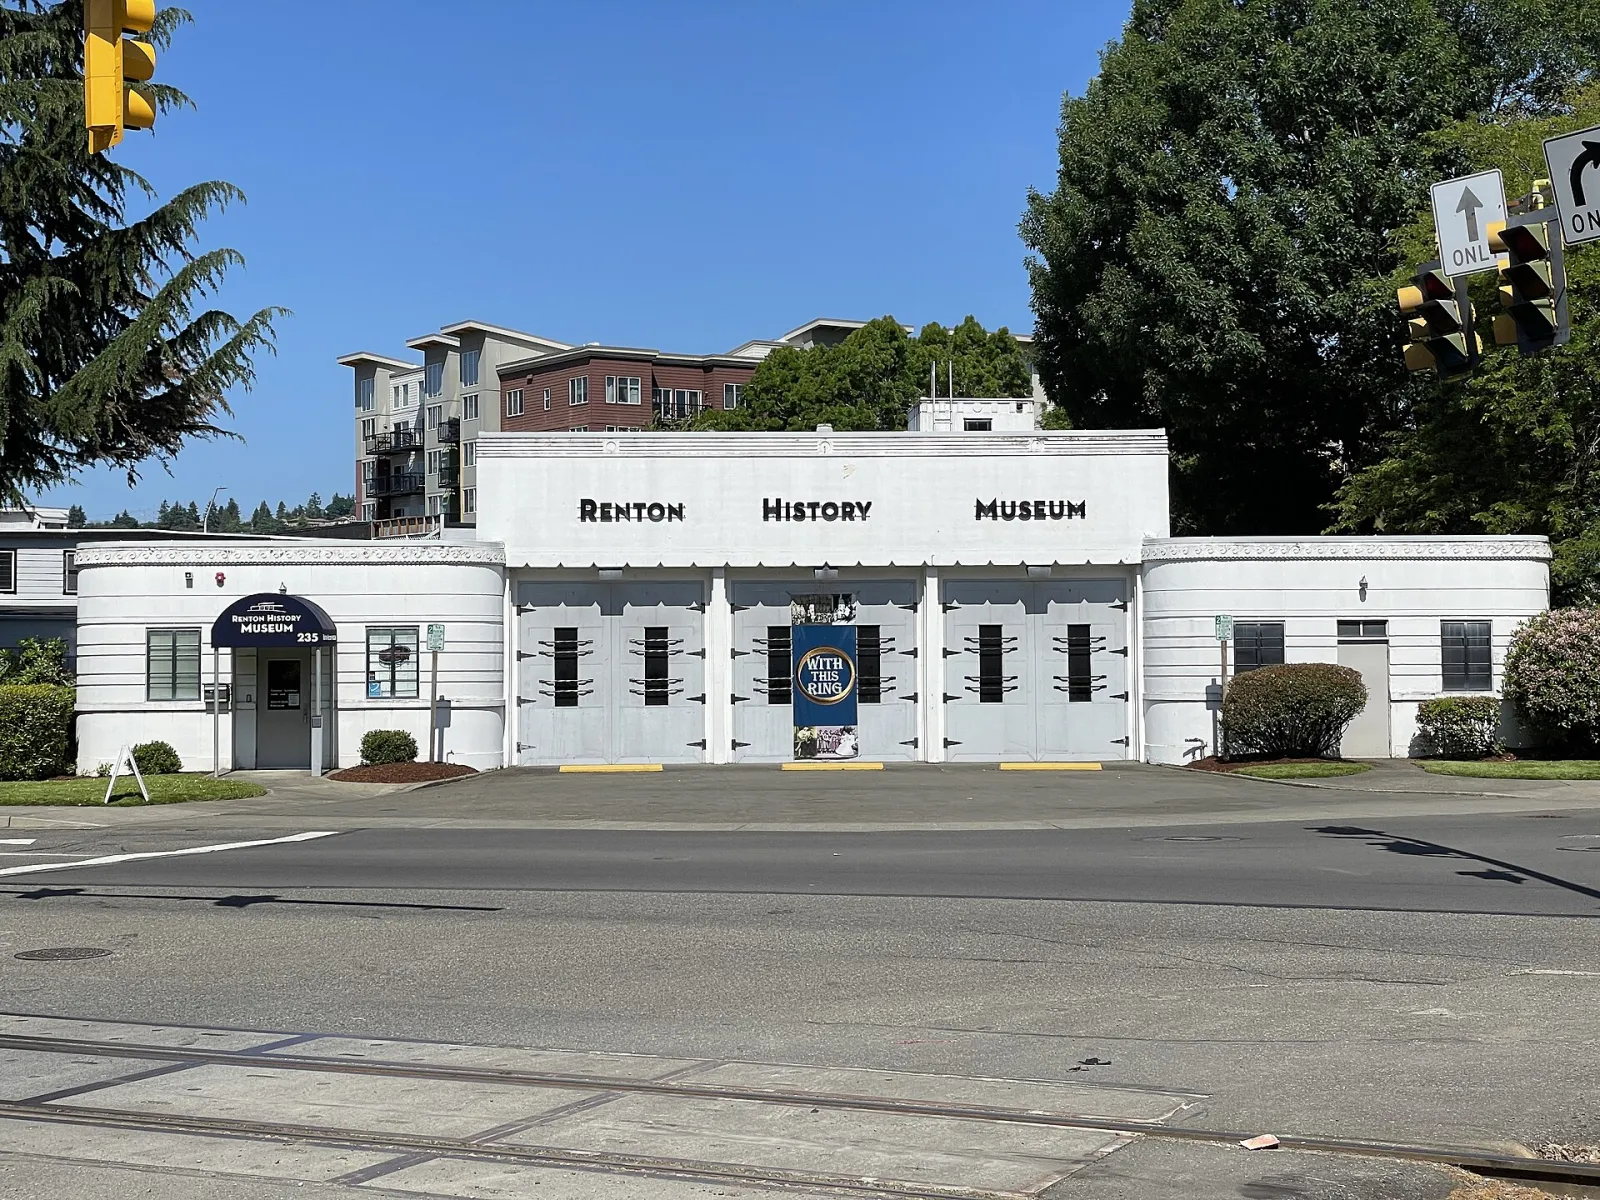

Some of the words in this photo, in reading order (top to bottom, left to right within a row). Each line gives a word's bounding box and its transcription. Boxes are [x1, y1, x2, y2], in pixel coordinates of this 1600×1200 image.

[1452, 244, 1497, 267] ONL
[580, 498, 684, 522] RENTON
[762, 498, 872, 522] HISTORY
[975, 497, 1086, 521] MUSEUM
[232, 615, 265, 623] RENTON
[267, 614, 301, 622] HISTORY
[240, 623, 293, 634] MUSEUM
[297, 632, 319, 643] 235
[806, 656, 843, 671] WITH
[811, 671, 839, 682] THIS
[807, 682, 842, 696] RING
